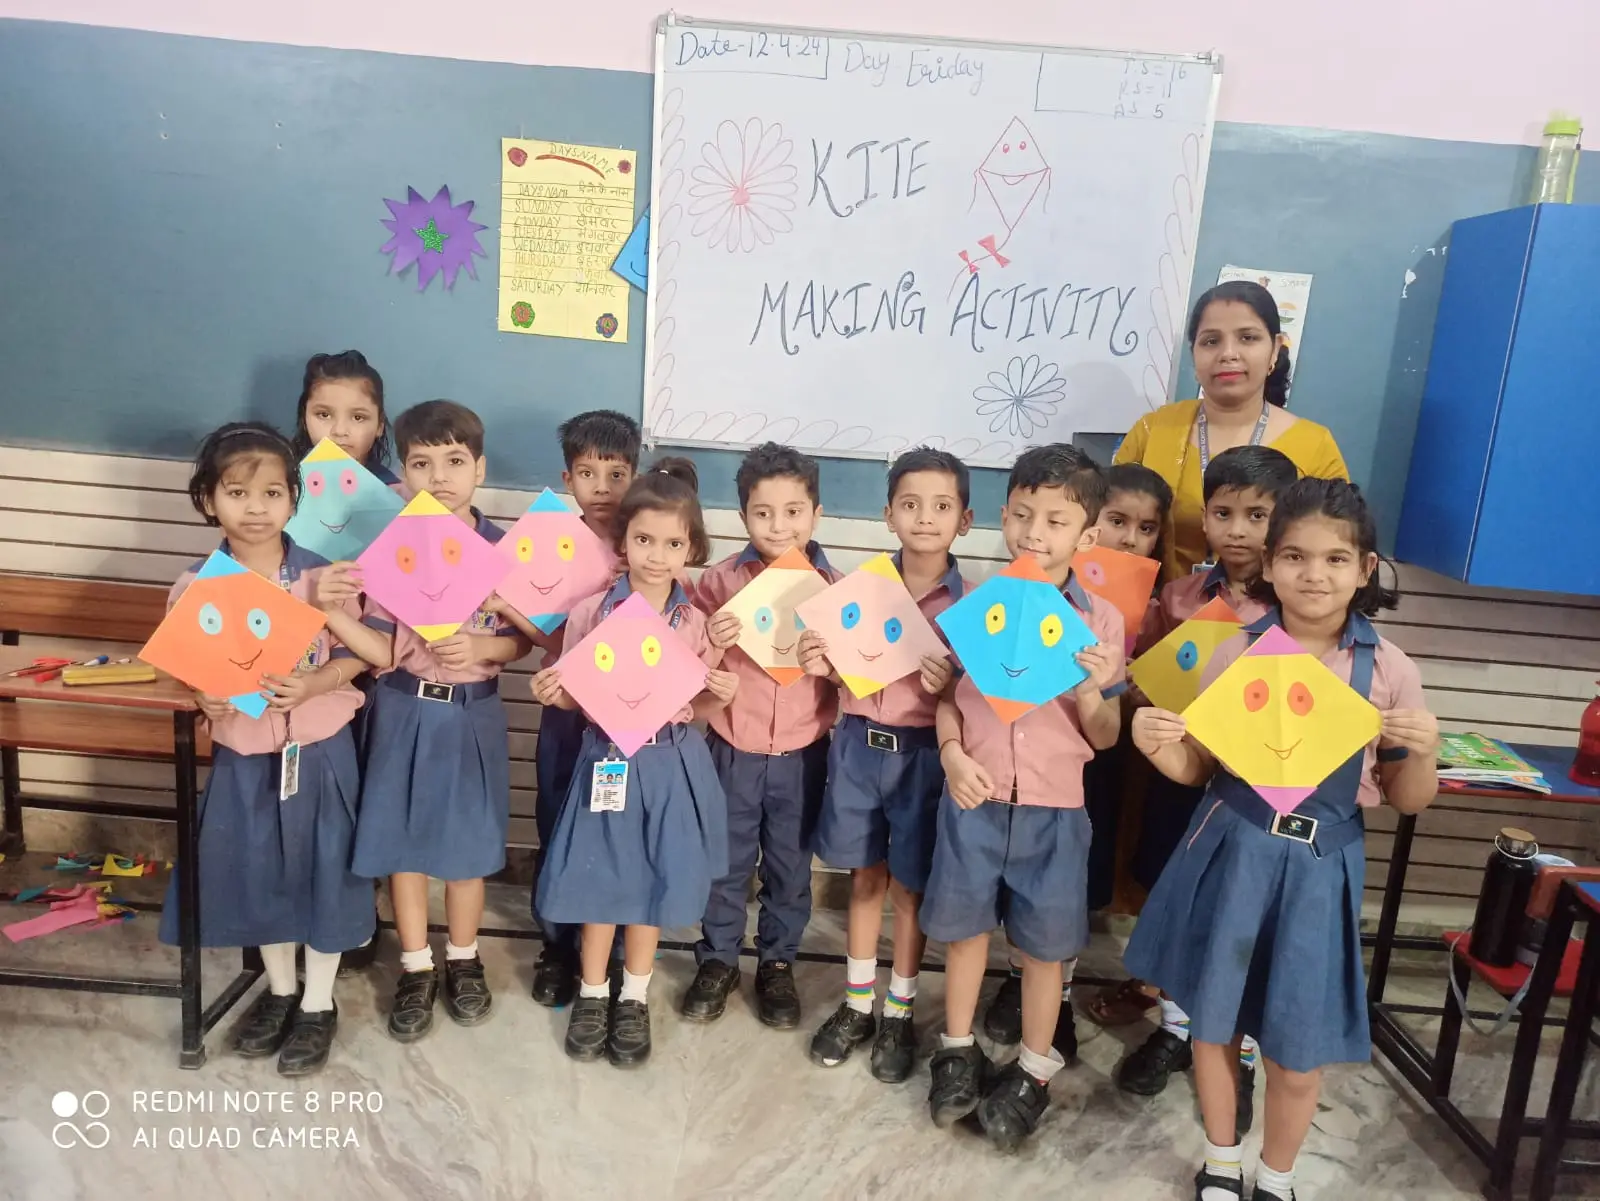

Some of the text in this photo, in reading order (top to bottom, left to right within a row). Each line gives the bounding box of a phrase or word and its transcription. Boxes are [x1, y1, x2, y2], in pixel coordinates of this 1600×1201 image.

[808, 137, 932, 218] KITE
[515, 199, 562, 214] SUNDAY
[513, 226, 562, 240] TUESDAY
[513, 237, 570, 254] WEDNESDAY
[514, 251, 566, 268] THURSDAY
[510, 277, 566, 296] SATURDAY
[749, 271, 1140, 356] MAKING ACTIVITY
